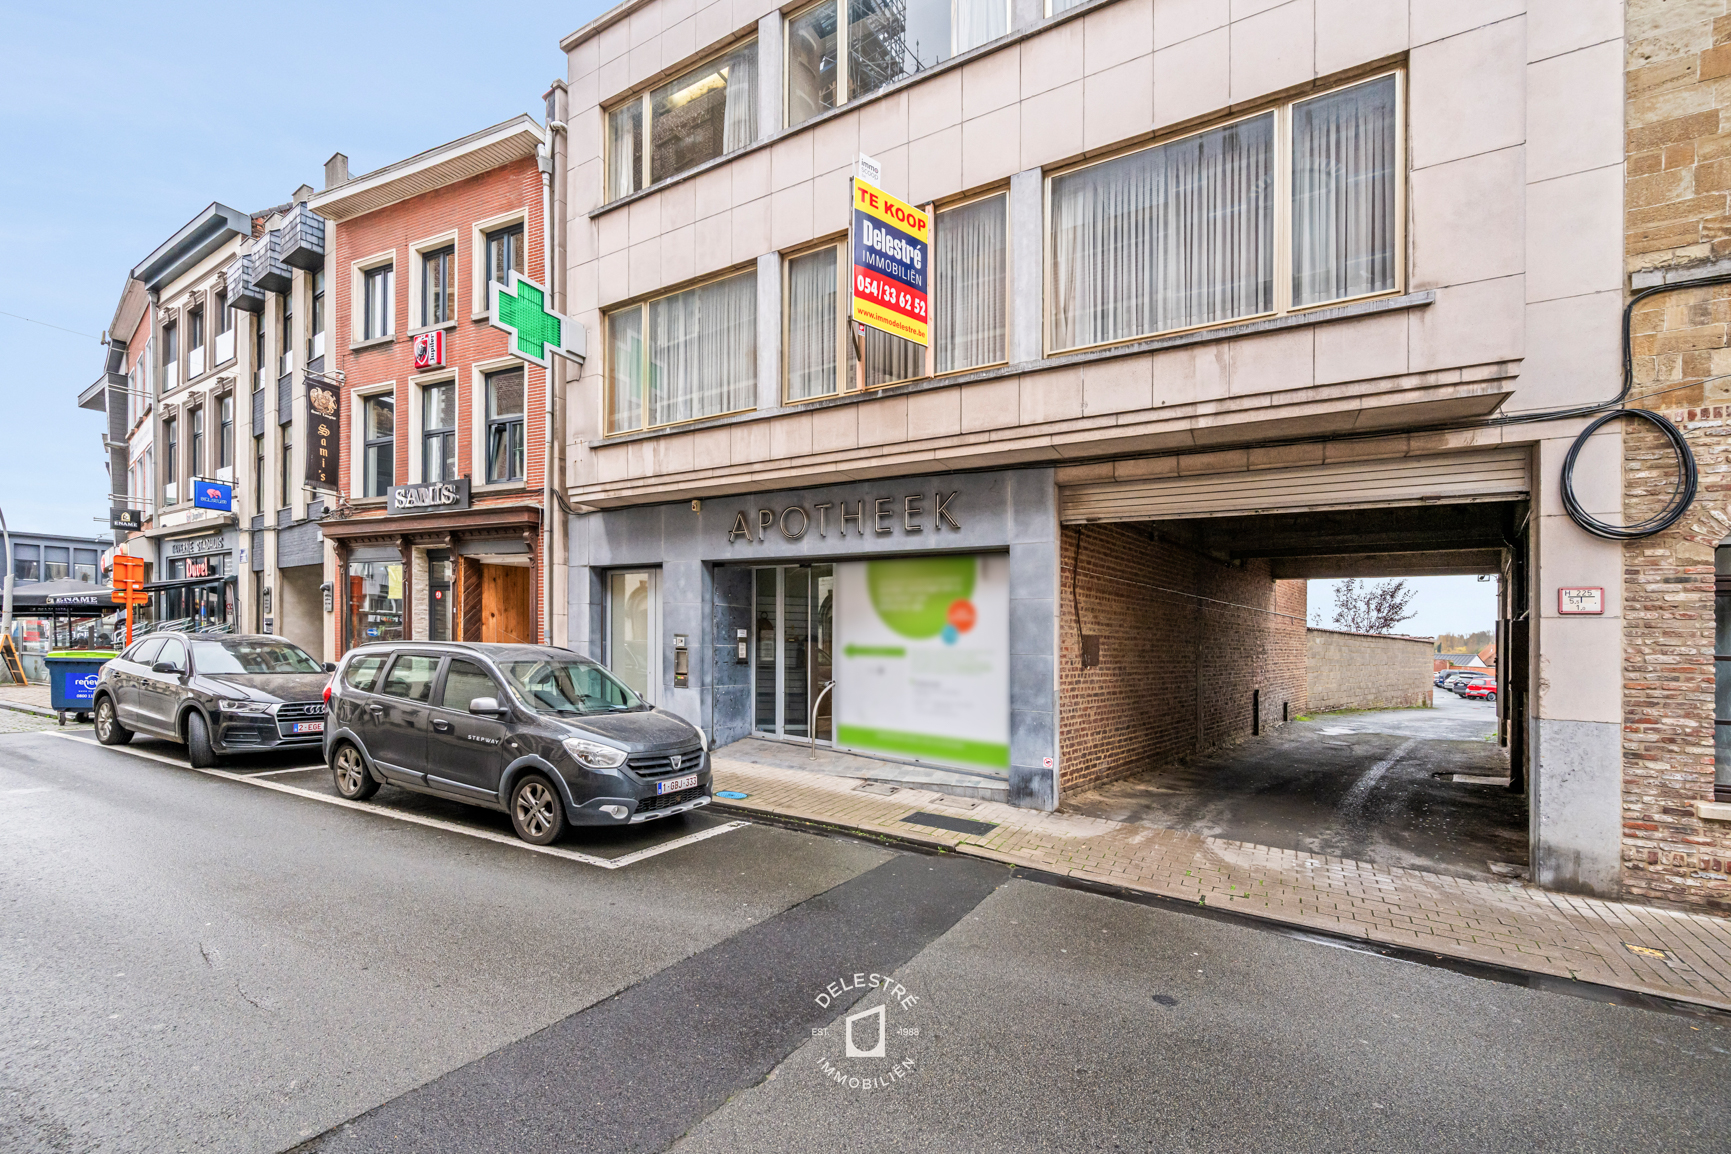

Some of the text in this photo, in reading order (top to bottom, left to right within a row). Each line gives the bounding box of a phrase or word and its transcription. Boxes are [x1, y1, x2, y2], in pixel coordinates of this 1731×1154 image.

[861, 158, 879, 173] immo
[858, 186, 926, 232] TE KOOP
[863, 219, 922, 269] Delestré
[862, 249, 922, 287] IMMOBILIËN
[899, 292, 912, 311] 62
[914, 298, 926, 317] 52
[857, 308, 926, 338] www.immodelestre.be
[728, 490, 961, 543] APOTHEEK
[186, 556, 208, 578] Duvel
[467, 734, 500, 745] STEPWAY
[663, 776, 697, 792] 1-GBJ-333
